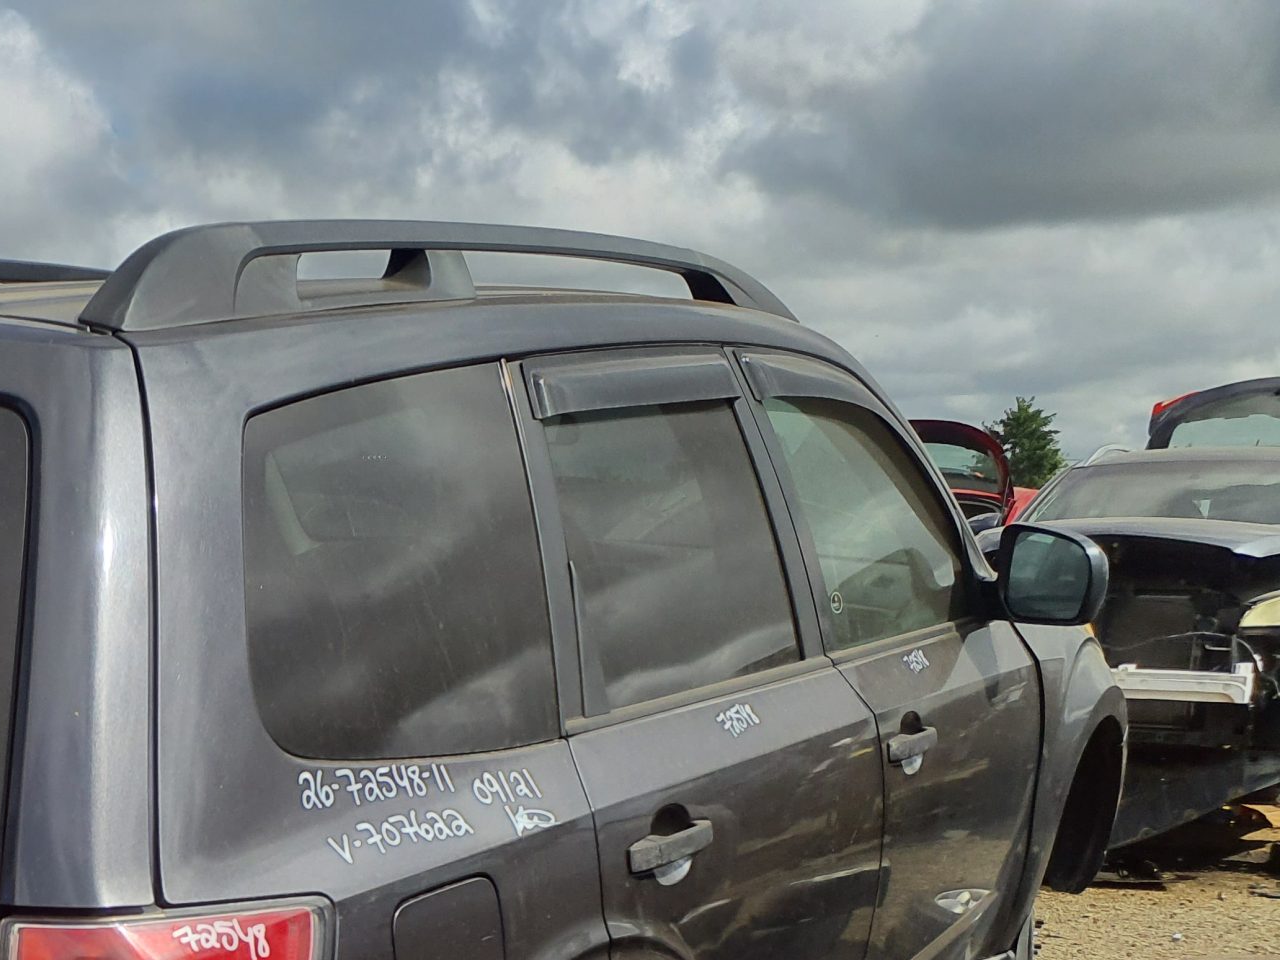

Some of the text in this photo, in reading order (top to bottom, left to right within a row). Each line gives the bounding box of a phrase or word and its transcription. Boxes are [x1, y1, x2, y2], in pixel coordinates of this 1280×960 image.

[715, 703, 760, 738] 72548
[298, 764, 455, 810] 26-72548-11
[172, 918, 271, 960] 72548
